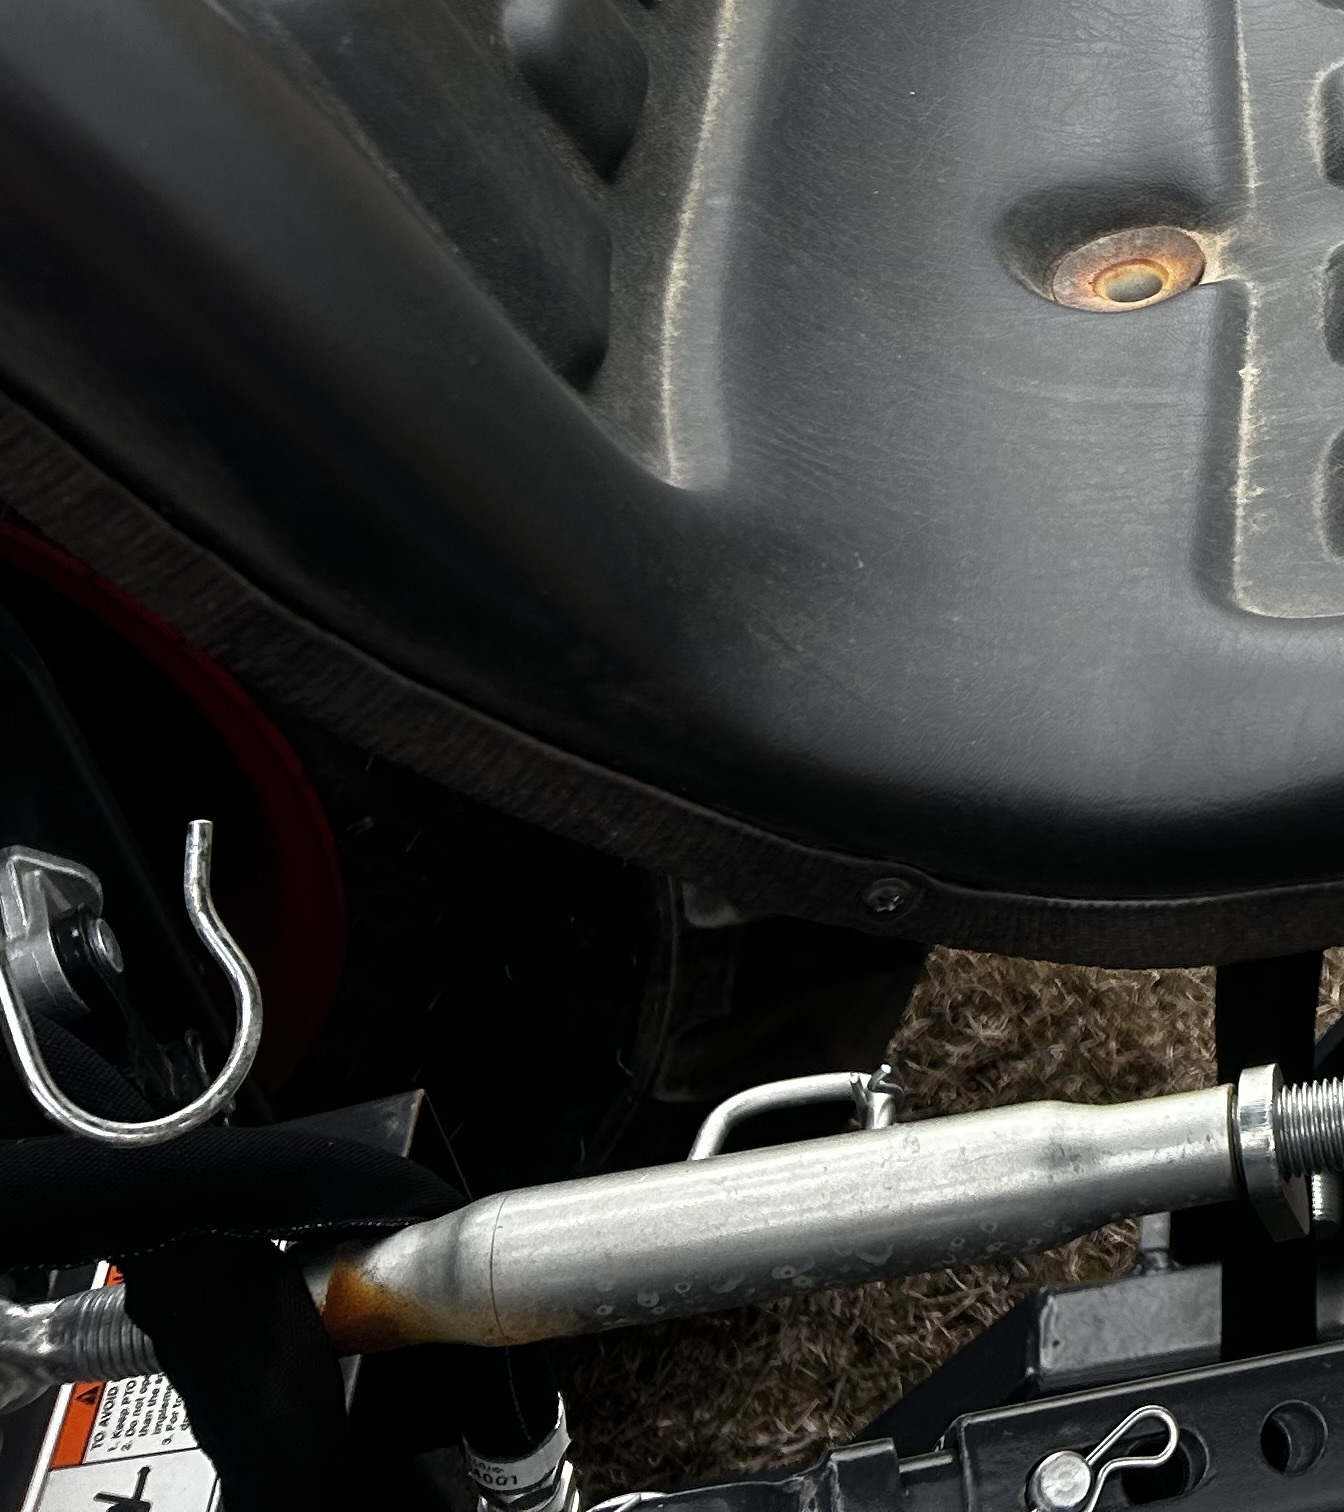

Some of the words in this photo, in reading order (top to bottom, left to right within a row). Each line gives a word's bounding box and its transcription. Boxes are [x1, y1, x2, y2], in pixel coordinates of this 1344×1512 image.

[91, 1430, 107, 1452] TO
[99, 1386, 119, 1427] AVOID
[112, 1408, 130, 1439] Keep
[121, 1380, 138, 1406] PTO
[125, 1420, 139, 1438] Do
[133, 1398, 145, 1417] not
[138, 1411, 153, 1437] than
[147, 1388, 160, 1407] the
